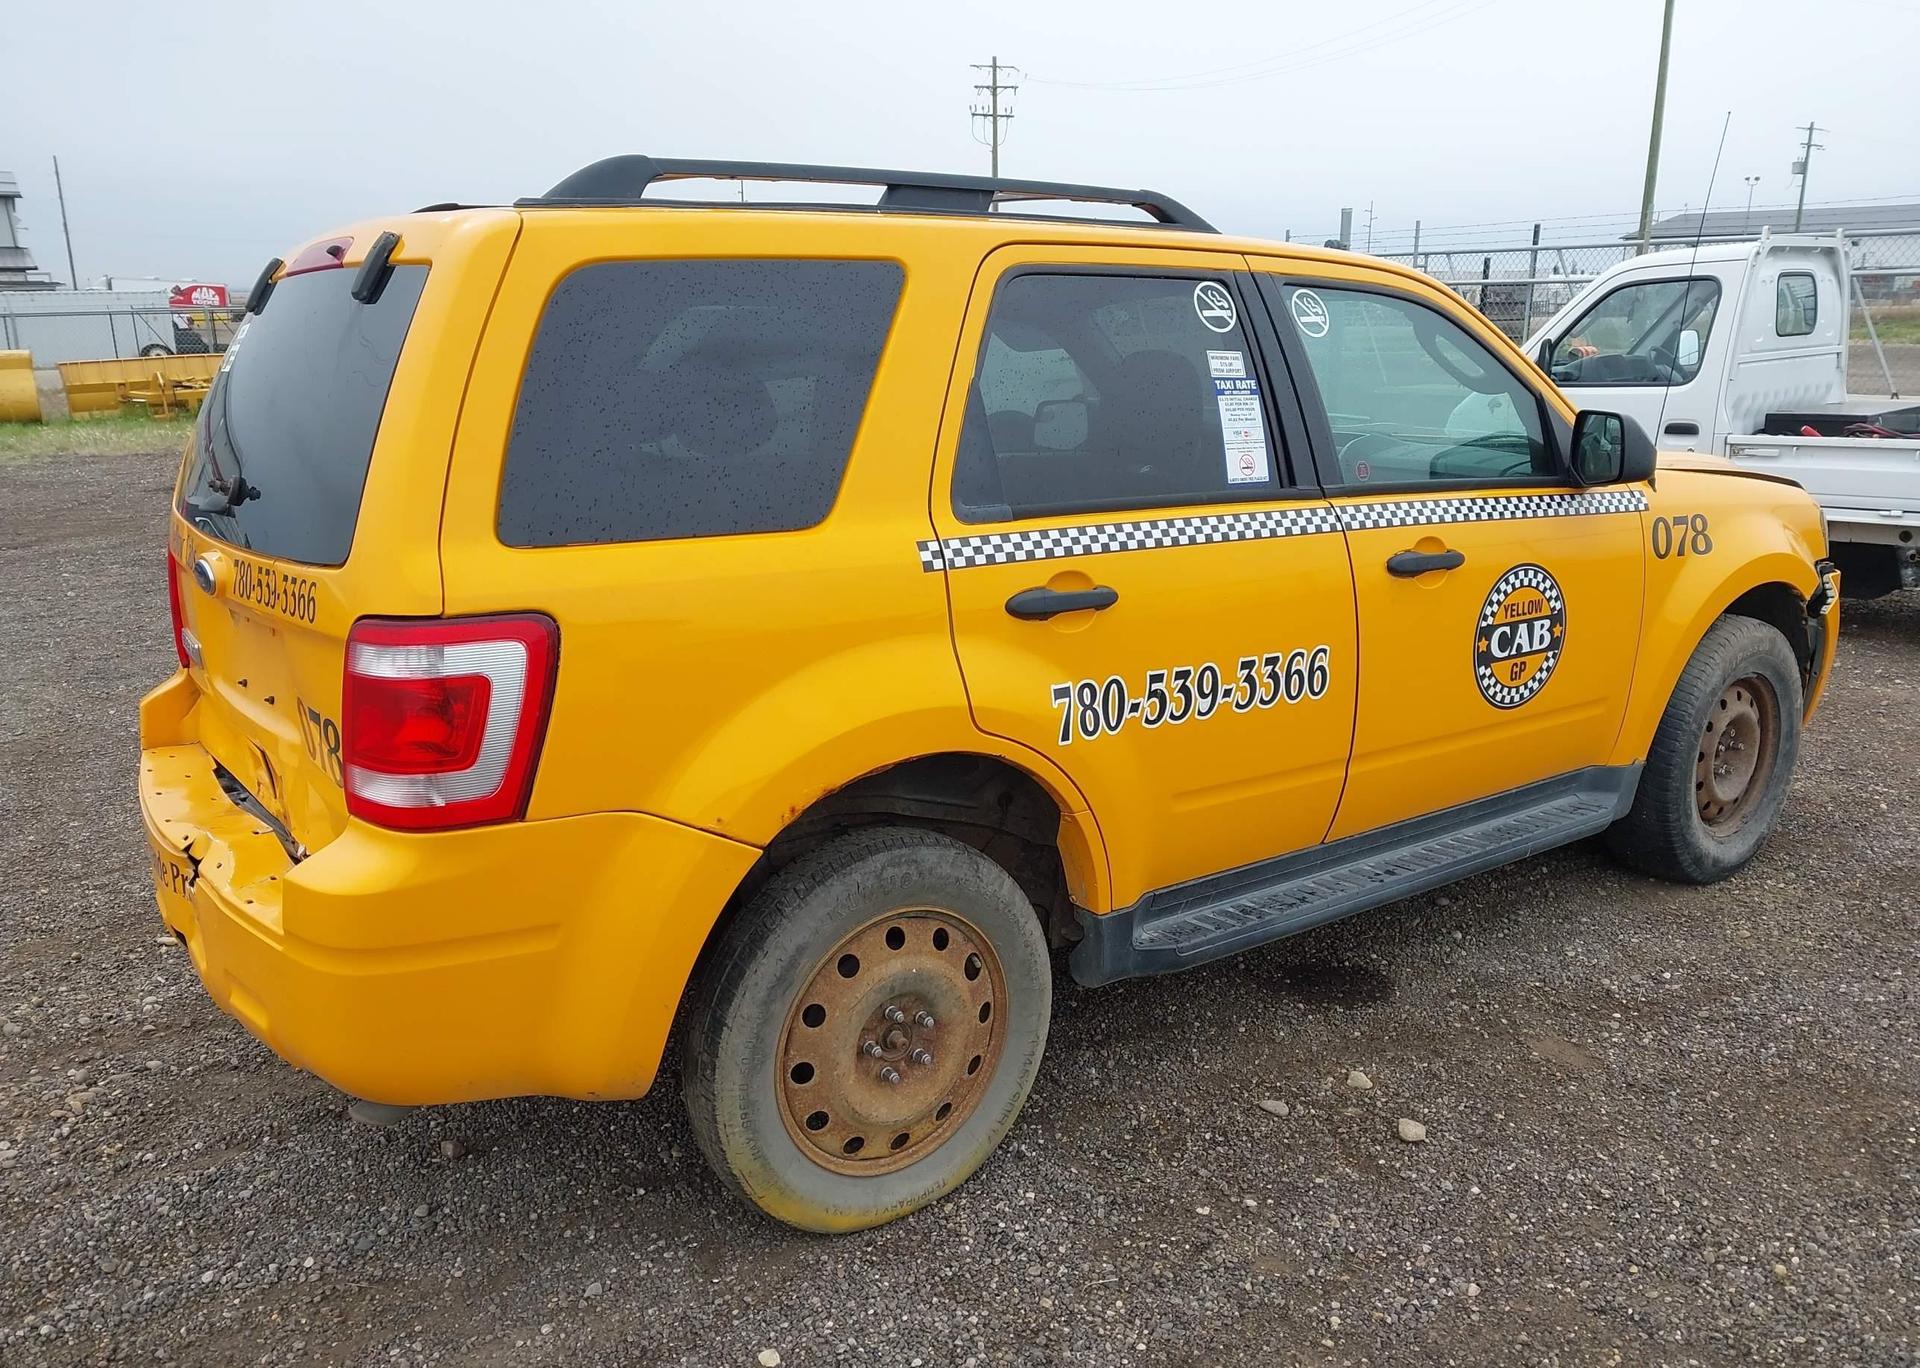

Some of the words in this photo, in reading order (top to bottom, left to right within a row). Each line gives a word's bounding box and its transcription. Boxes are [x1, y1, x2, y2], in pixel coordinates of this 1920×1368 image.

[1214, 380, 1235, 390] TAXI
[1236, 380, 1257, 390] RATE
[1652, 513, 1713, 559] 078
[232, 559, 317, 624] 780-539-3366
[1503, 598, 1543, 619] YELLOW
[1490, 618, 1551, 658] CAB
[1510, 661, 1527, 681] GP
[1051, 644, 1330, 746] 780-539-3366
[297, 696, 343, 789] 078
